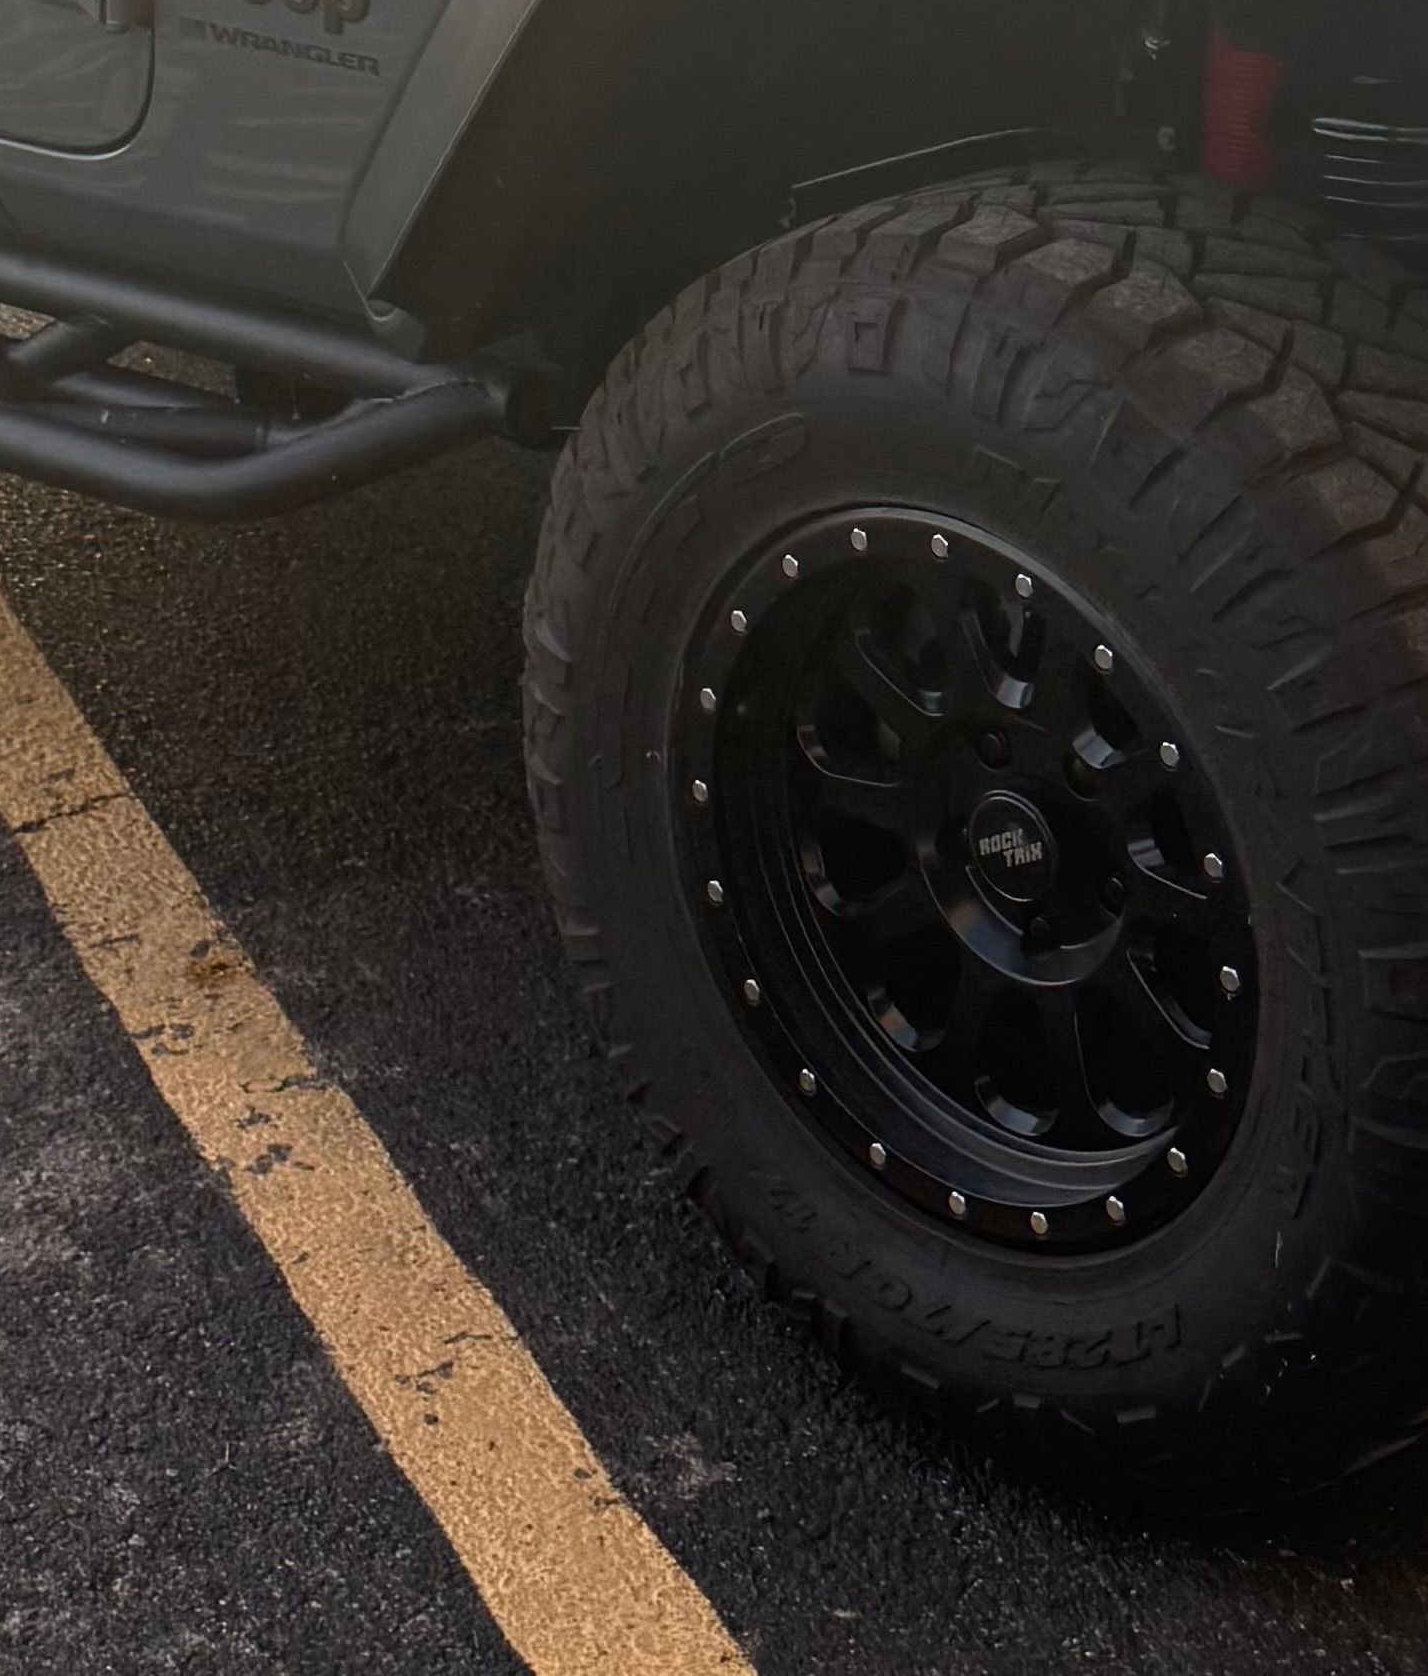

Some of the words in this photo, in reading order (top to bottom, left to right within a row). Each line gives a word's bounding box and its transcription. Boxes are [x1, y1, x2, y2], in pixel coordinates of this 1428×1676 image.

[207, 22, 380, 77] WRANGLER
[978, 827, 1024, 857] ROCK
[1003, 840, 1043, 868] TRIX
